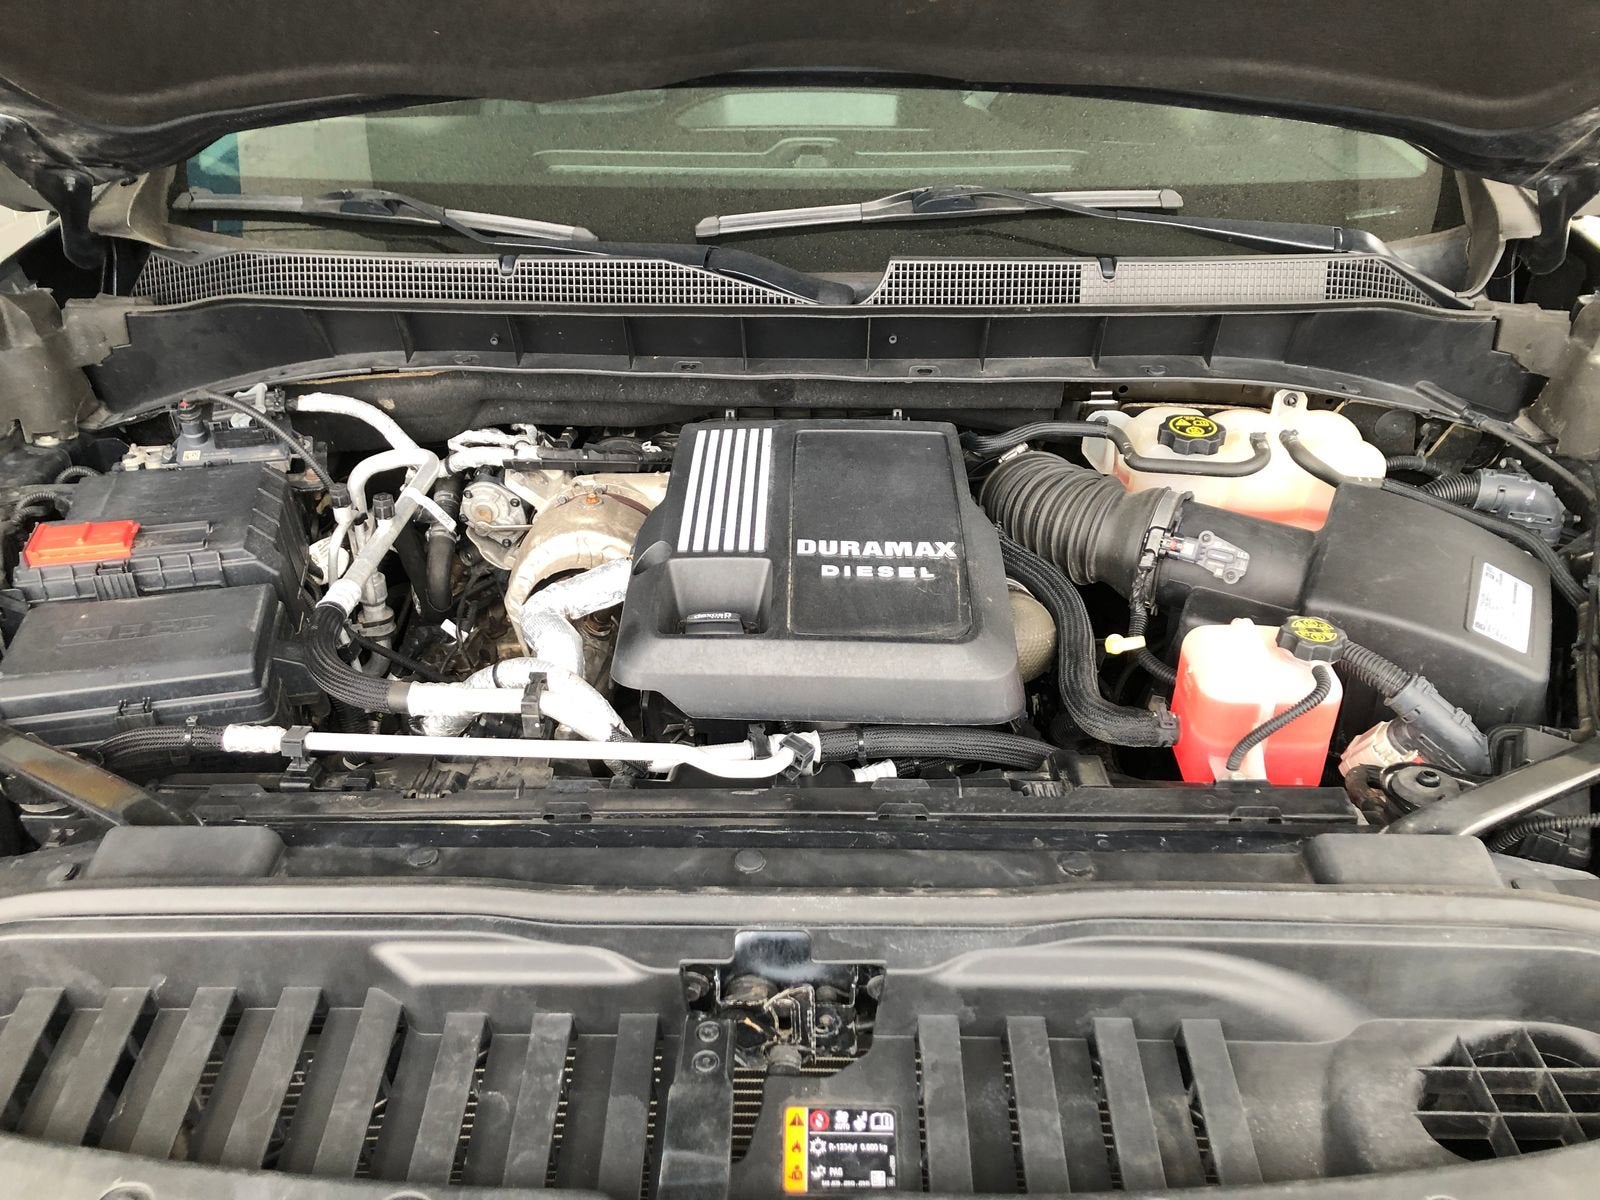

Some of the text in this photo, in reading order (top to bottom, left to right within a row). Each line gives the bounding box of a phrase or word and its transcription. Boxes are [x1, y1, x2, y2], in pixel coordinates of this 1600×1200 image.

[796, 538, 958, 559] DURAMAX
[821, 564, 936, 580] DIESEL
[879, 1143, 888, 1153] kg
